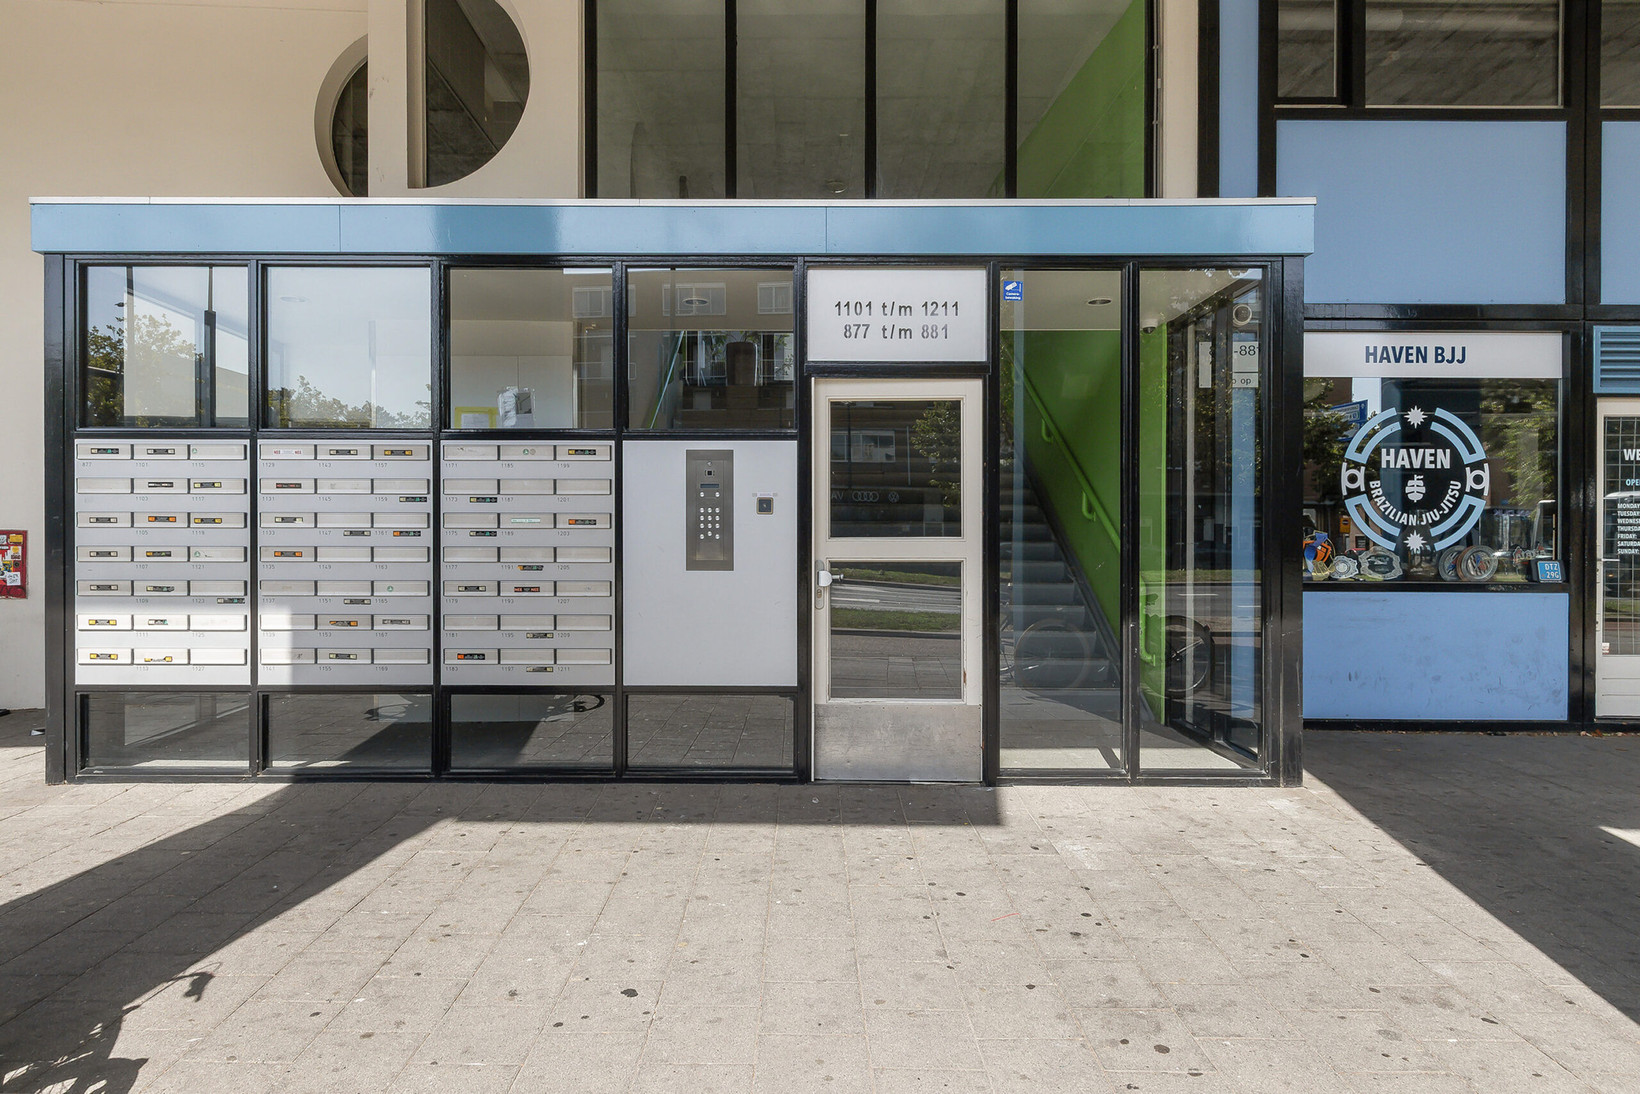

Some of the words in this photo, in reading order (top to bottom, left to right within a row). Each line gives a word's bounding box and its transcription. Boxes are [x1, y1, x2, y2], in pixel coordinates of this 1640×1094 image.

[834, 301, 872, 316] 1101
[882, 301, 912, 316] t/m
[922, 301, 958, 316] 1211
[844, 324, 870, 339] 877
[882, 324, 912, 339] t/m
[921, 324, 948, 339] 881
[1365, 346, 1428, 364] HAVEN
[1434, 346, 1466, 364] BJJ
[1381, 448, 1450, 468] HAVEN
[1369, 480, 1416, 526] BRAZILIAN
[1420, 480, 1462, 526] JIU-JITSU
